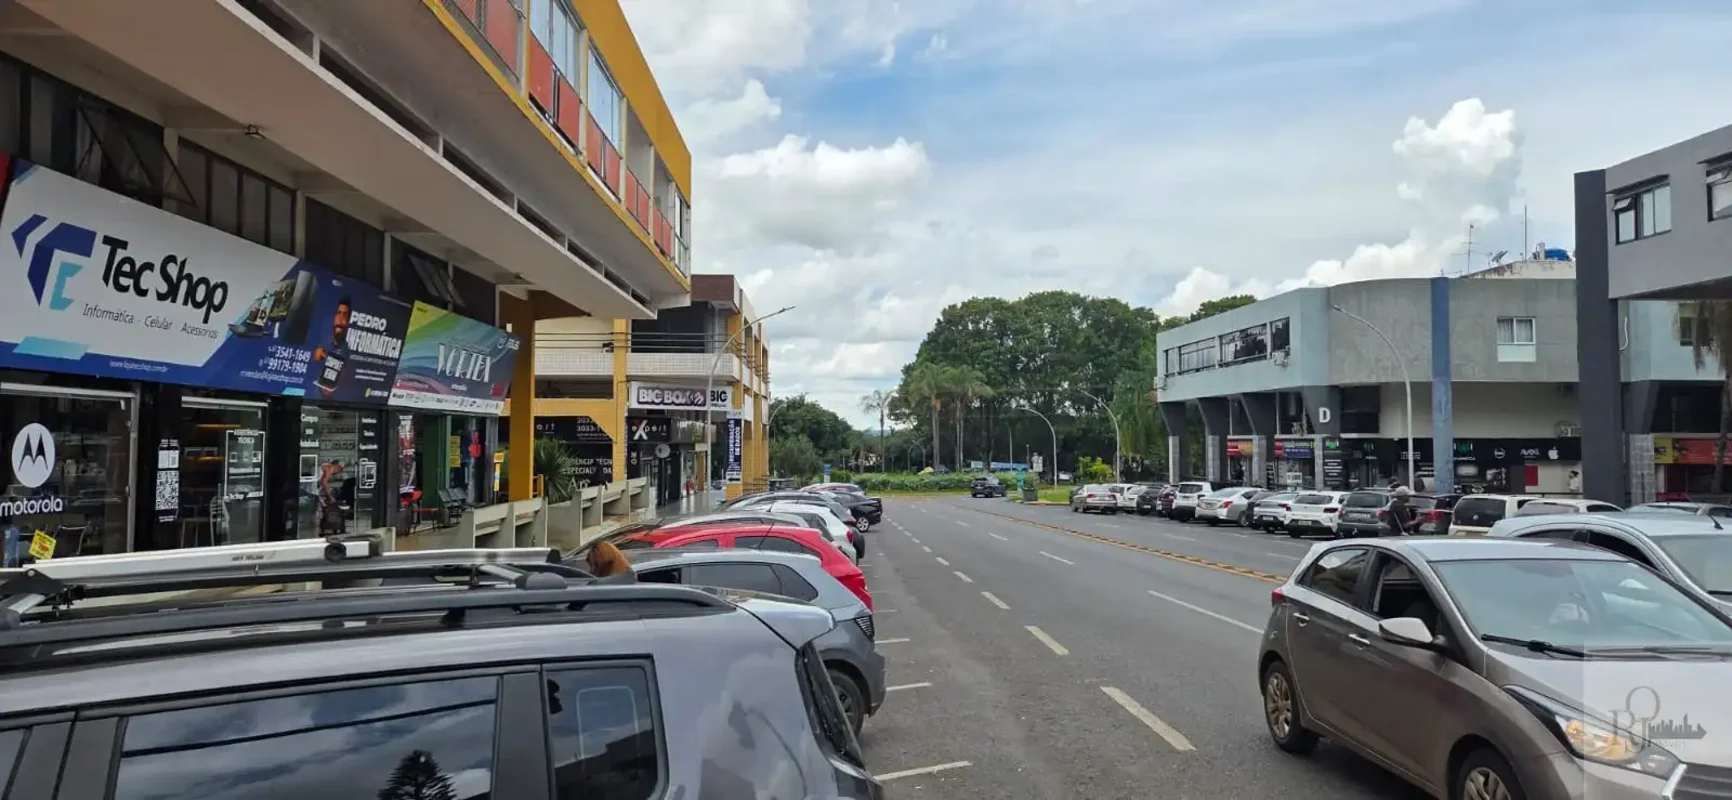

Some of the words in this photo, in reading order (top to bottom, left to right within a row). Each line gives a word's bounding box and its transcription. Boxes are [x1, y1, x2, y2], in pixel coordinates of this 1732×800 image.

[144, 315, 173, 331] Celular
[349, 310, 387, 331] PEDRO
[346, 328, 402, 359] INFORMÁTICA
[639, 388, 662, 404] BIG
[710, 390, 728, 402] BIG
[1318, 407, 1331, 423] D
[0, 495, 63, 517] motorola
